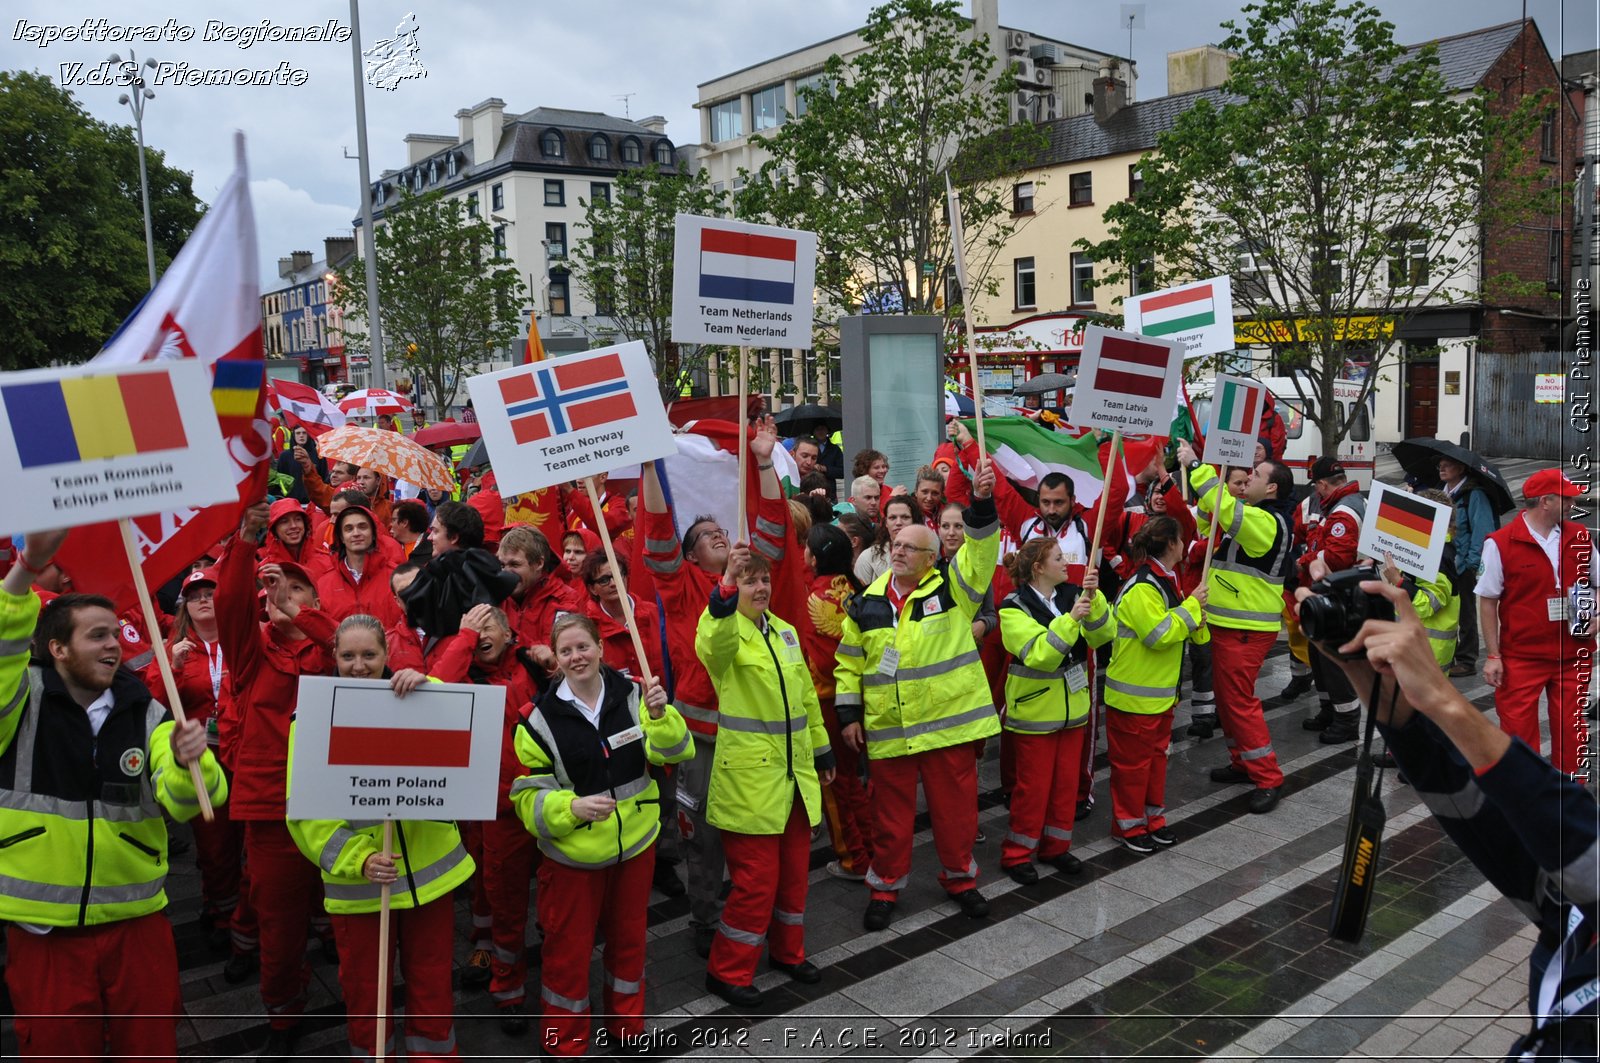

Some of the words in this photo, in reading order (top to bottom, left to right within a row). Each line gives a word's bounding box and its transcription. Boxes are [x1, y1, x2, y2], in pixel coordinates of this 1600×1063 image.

[700, 305, 729, 318] Team
[732, 307, 793, 322] Netherlands
[704, 322, 733, 335] Team
[736, 324, 788, 338] Nederland
[1176, 332, 1204, 343] Hungry
[1184, 342, 1203, 351] apat
[1332, 387, 1363, 399] BULANC
[1103, 399, 1124, 410] Team
[1125, 401, 1148, 413] Latvia
[1091, 411, 1127, 424] Komanda
[1128, 414, 1153, 428] Latvija
[540, 442, 575, 457] Team
[577, 430, 625, 448] Norway
[1221, 437, 1231, 445] Team
[1231, 438, 1242, 448] Italy
[544, 453, 592, 472] Teamet
[593, 444, 631, 460] Norge
[1218, 448, 1229, 457] Team
[1229, 449, 1240, 458] Italia
[52, 473, 99, 489] Team
[104, 462, 174, 482] Romania
[52, 491, 109, 510] Echipa
[114, 480, 183, 500] România
[1371, 543, 1386, 555] Team
[1377, 535, 1393, 547] Team
[1394, 543, 1421, 560] Germany
[350, 776, 391, 788] Team
[396, 776, 447, 788] Poland
[349, 794, 391, 806] Team
[396, 794, 444, 806] Polska
[1575, 977, 1599, 1004] FAC
